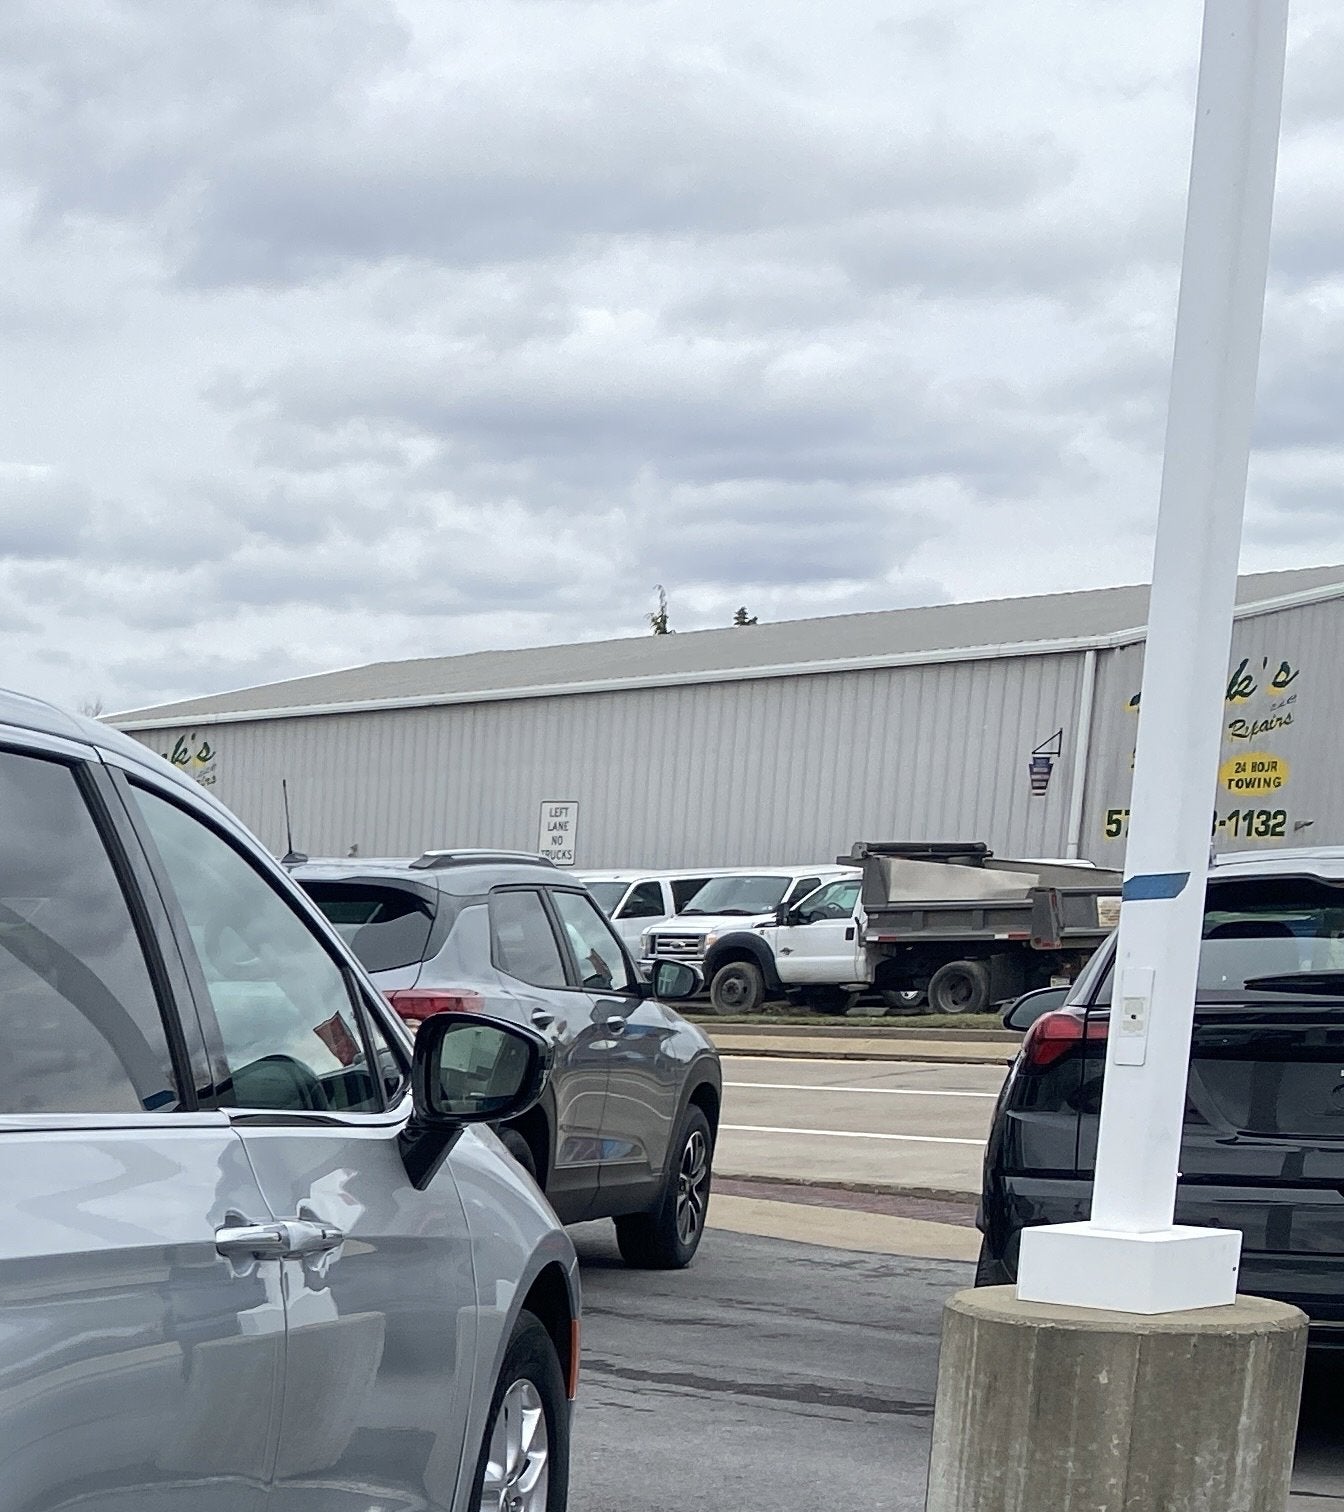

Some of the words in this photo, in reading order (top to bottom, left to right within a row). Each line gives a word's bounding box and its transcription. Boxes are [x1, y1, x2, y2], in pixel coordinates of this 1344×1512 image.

[1224, 656, 1300, 702] k's
[161, 732, 217, 765] k's
[1227, 776, 1282, 790] TOWING
[549, 806, 569, 818] LEFT
[547, 820, 570, 832] LANE
[551, 834, 564, 846] NO
